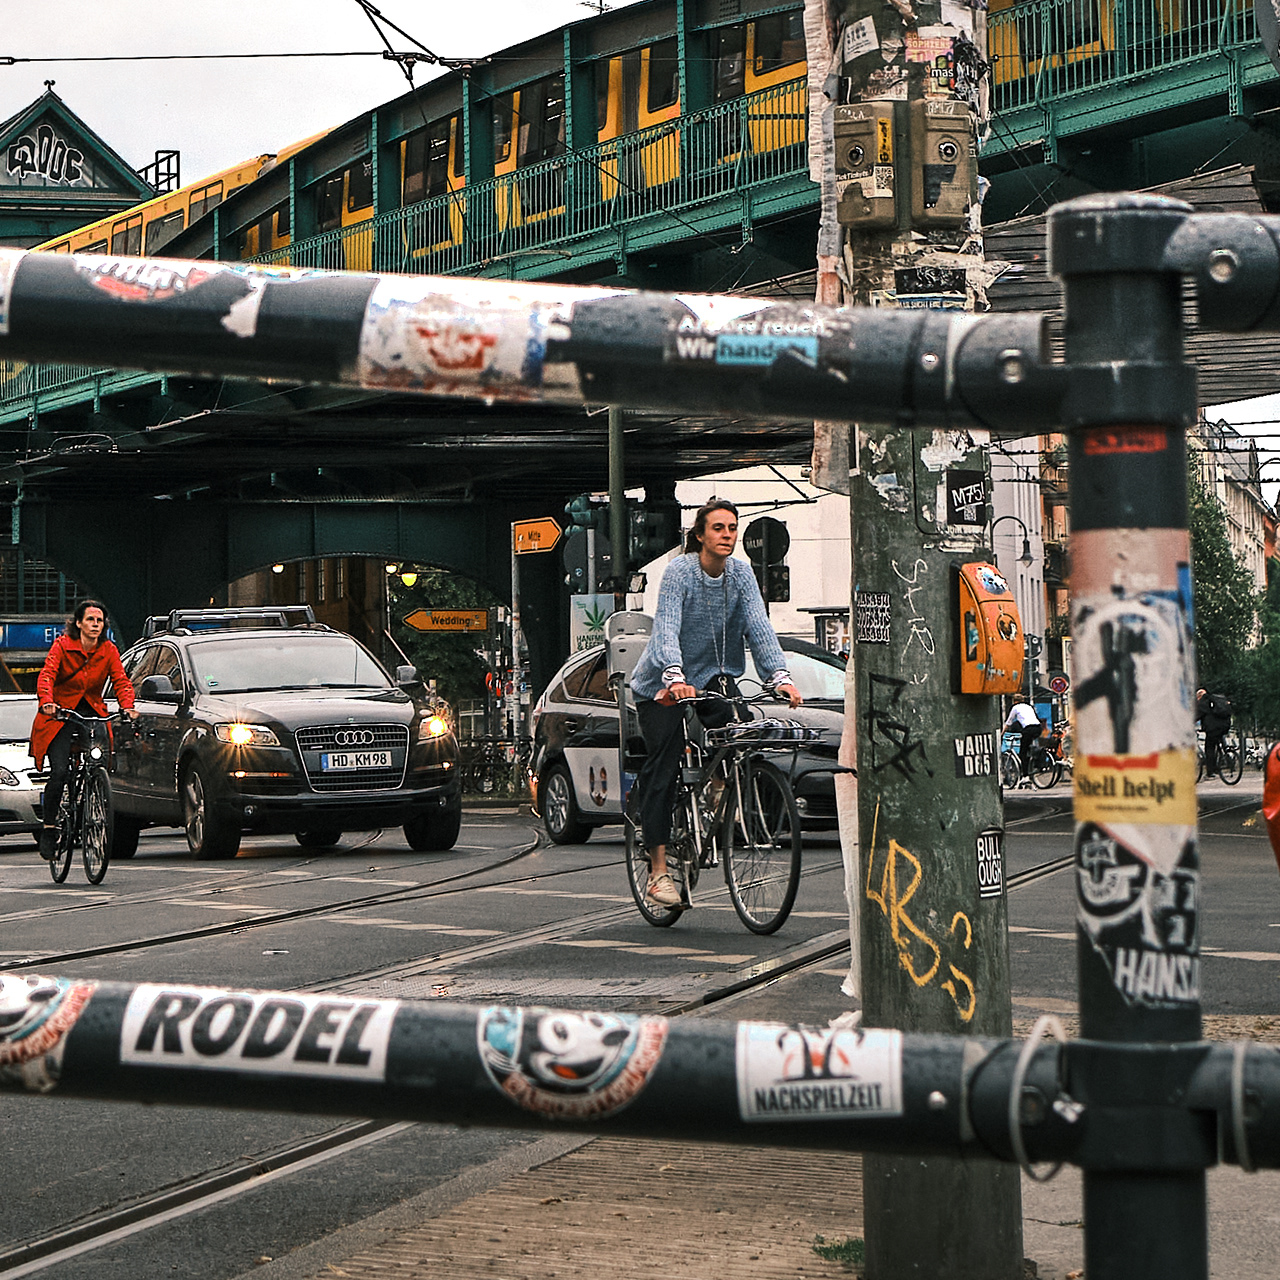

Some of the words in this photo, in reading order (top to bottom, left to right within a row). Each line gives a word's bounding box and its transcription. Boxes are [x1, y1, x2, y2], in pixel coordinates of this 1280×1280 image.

[677, 337, 716, 359] Wir
[528, 530, 541, 541] Mitte
[431, 615, 471, 627] Wedding
[576, 635, 605, 643] HANFME
[332, 754, 348, 767] HD
[977, 837, 1000, 861] BULL
[754, 1083, 884, 1115] NACHSPIELZEIT
